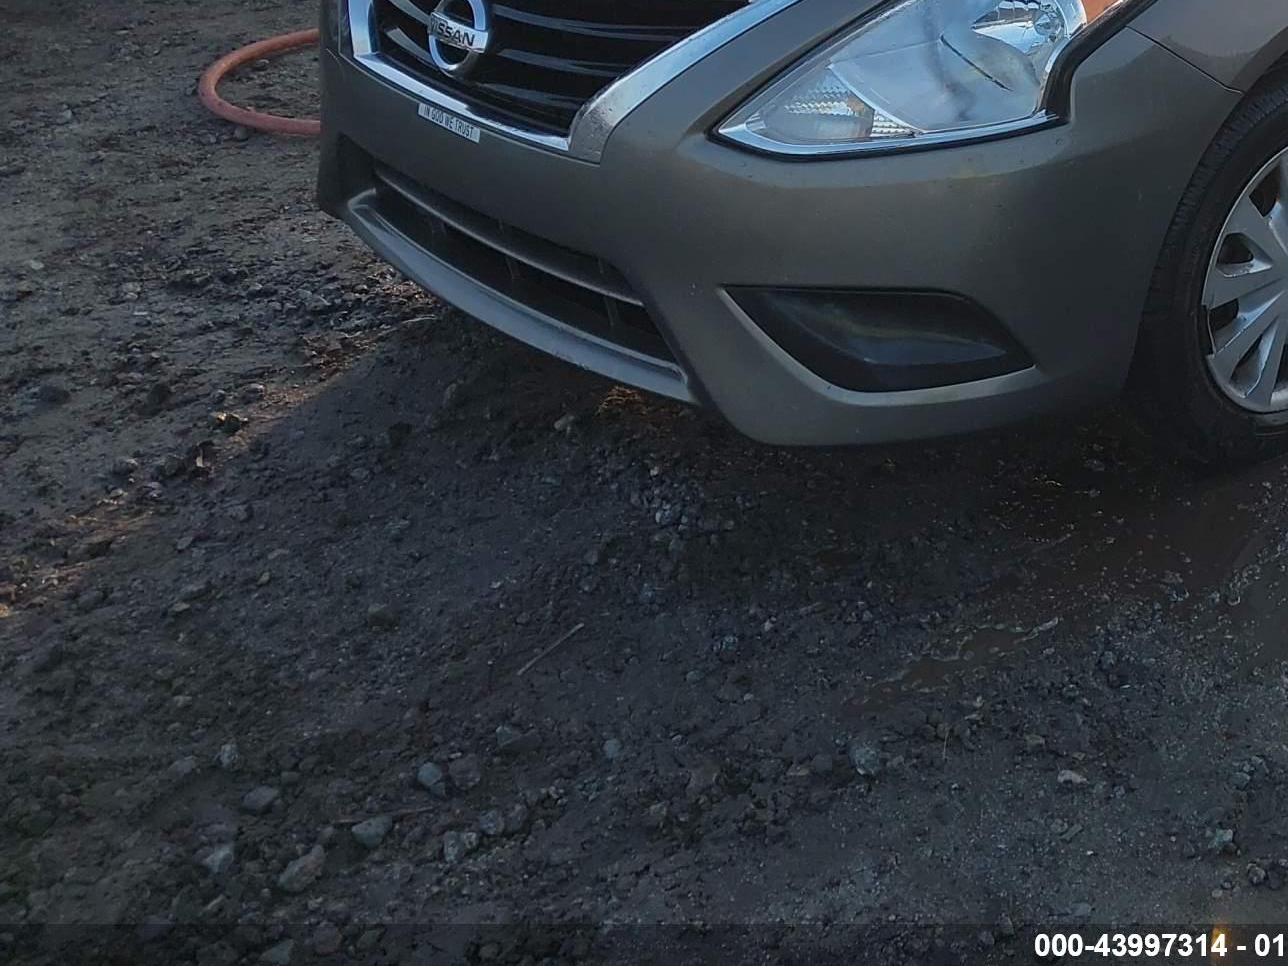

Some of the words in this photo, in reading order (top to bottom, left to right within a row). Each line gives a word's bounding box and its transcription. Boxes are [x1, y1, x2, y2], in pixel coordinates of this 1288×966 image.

[431, 14, 475, 47] NISSAN
[431, 109, 444, 124] GOD
[444, 114, 454, 130] WE
[454, 119, 474, 139] TRUST
